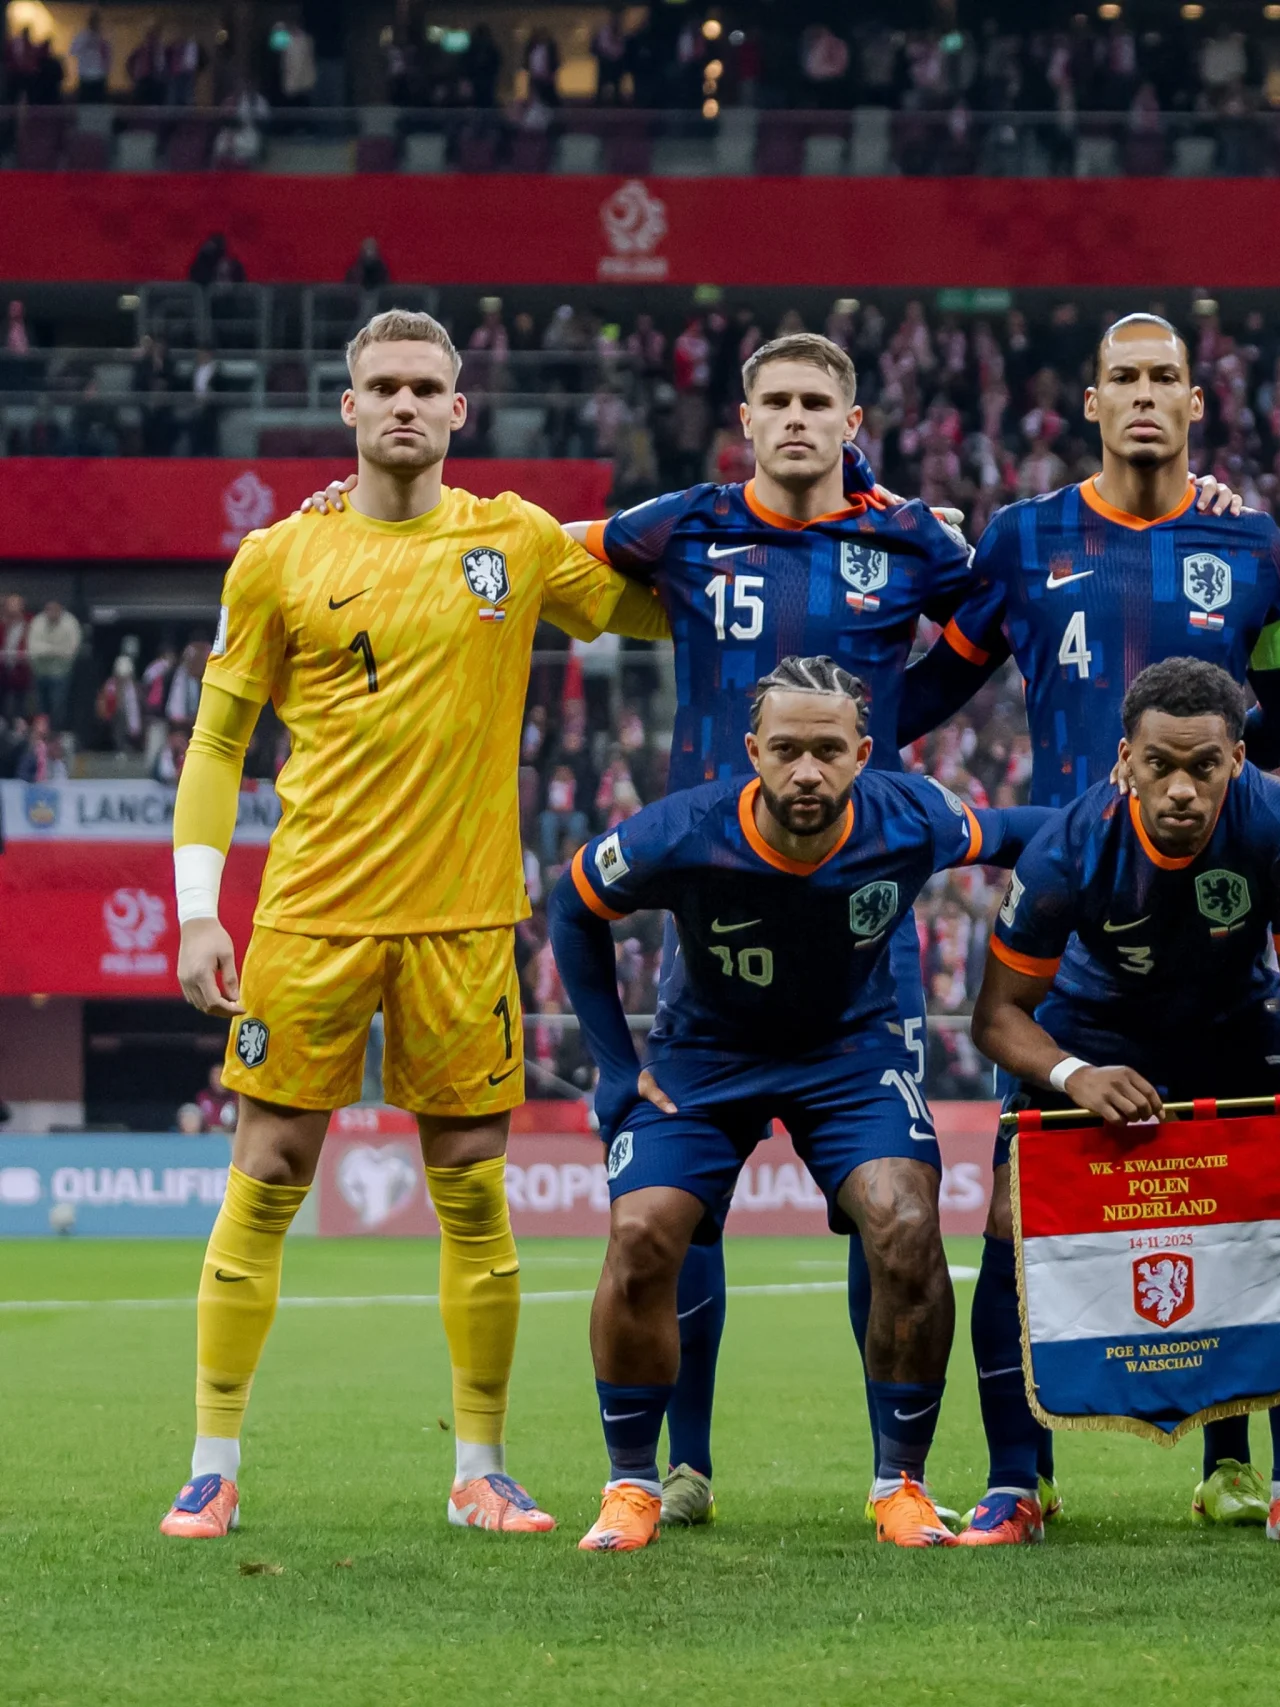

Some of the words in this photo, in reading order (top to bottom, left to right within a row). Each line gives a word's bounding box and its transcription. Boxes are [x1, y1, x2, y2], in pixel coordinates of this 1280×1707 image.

[704, 574, 764, 640] 15
[1058, 611, 1092, 679] 4
[349, 629, 379, 693] 1
[708, 945, 774, 987] 10
[493, 995, 512, 1060] 1
[1089, 1161, 1115, 1176] WK
[1124, 1154, 1229, 1174] KWALIFICATIE
[1128, 1176, 1190, 1197] POLEN
[1102, 1198, 1218, 1222] NEDERLAND
[1129, 1232, 1194, 1249] 14-11-2025
[1105, 1345, 1135, 1360] PGE
[1139, 1337, 1220, 1357] NARODOWY
[1124, 1354, 1203, 1373] WARSCHAU
